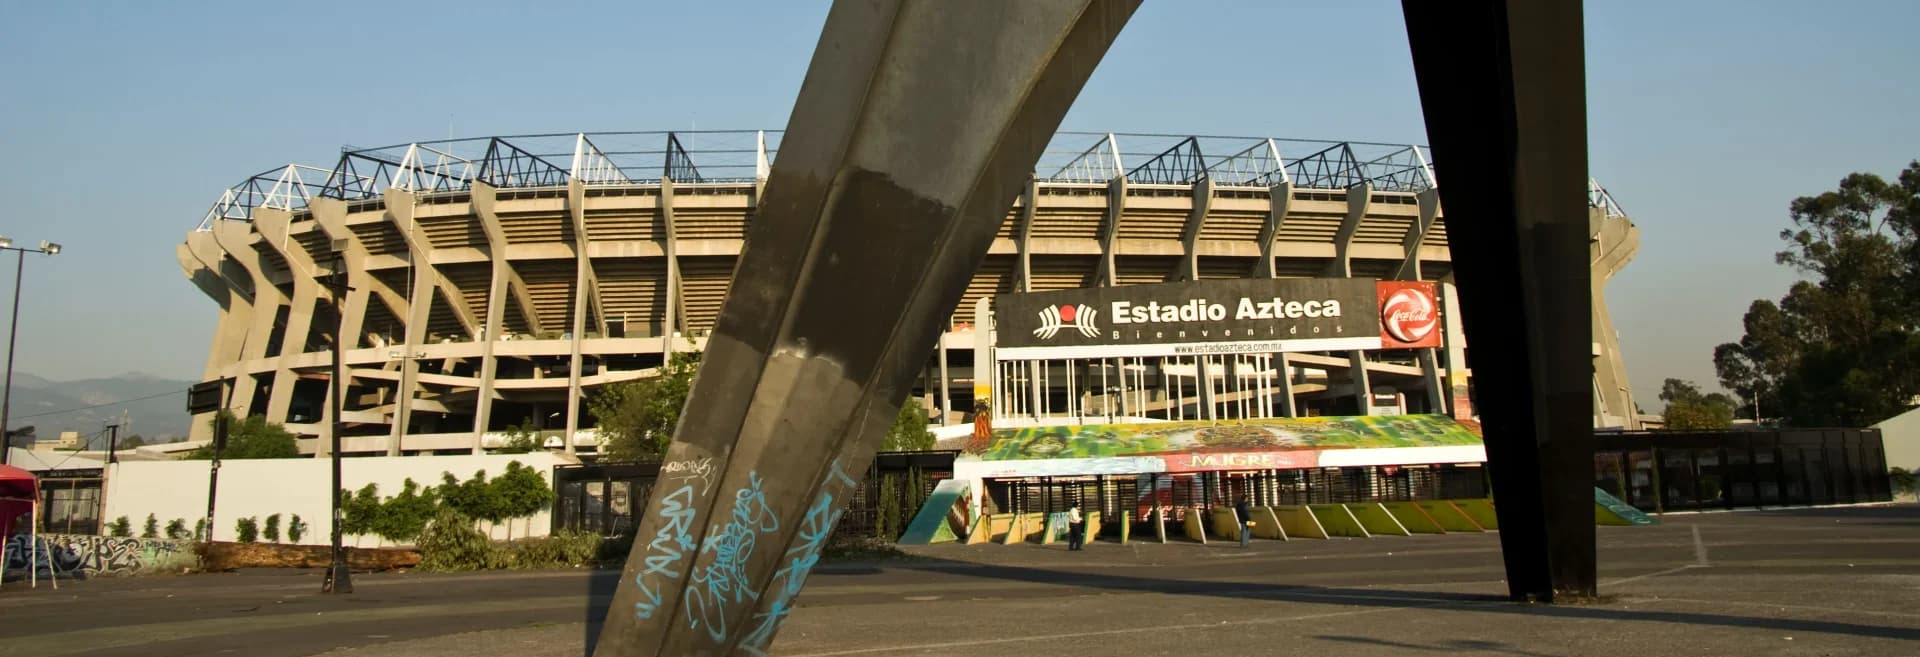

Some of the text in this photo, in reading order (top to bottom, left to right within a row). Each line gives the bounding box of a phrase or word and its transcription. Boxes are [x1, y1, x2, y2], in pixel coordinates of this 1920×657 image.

[1112, 297, 1342, 324] Estadio Azteca
[1112, 325, 1343, 340] Bienvenidos
[1174, 343, 1283, 354] www.estadioazteca.com.mx
